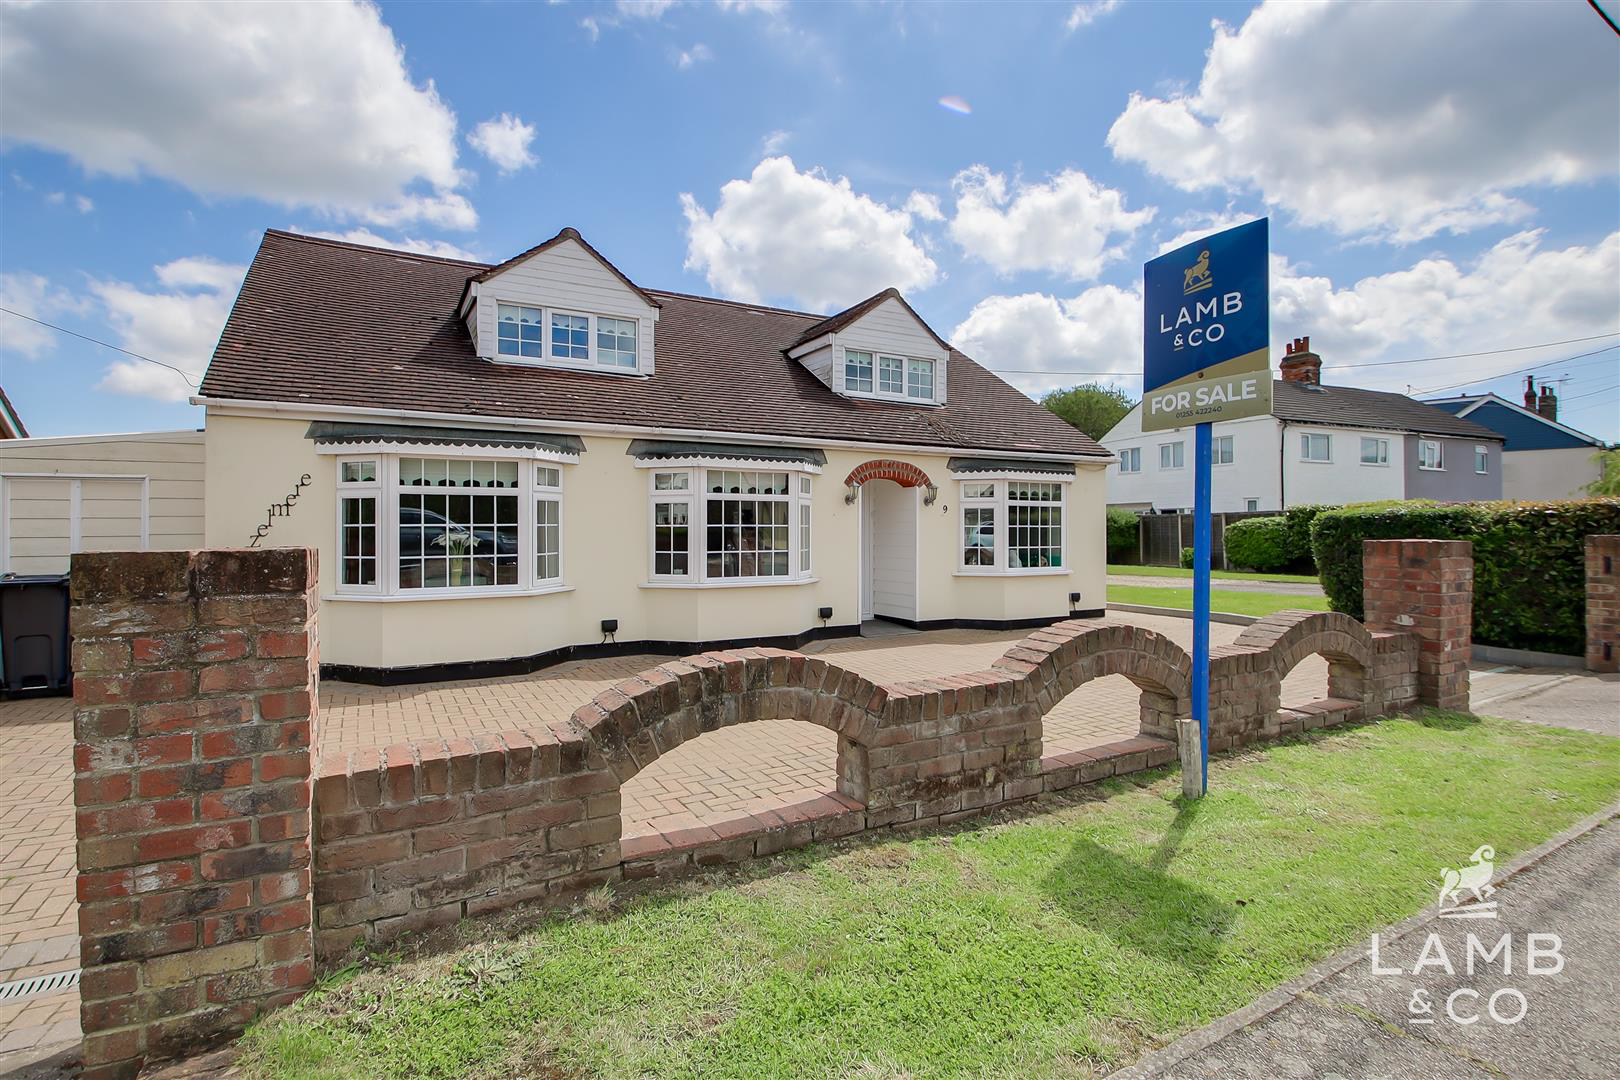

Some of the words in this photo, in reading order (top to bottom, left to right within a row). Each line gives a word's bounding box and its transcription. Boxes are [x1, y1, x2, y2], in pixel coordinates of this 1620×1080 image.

[1160, 291, 1243, 334] LAMB
[1151, 391, 1191, 415] FOR
[1195, 379, 1257, 406] SALE
[1175, 410, 1194, 419] 01255
[1195, 405, 1222, 415] 422240
[942, 504, 948, 514] 9
